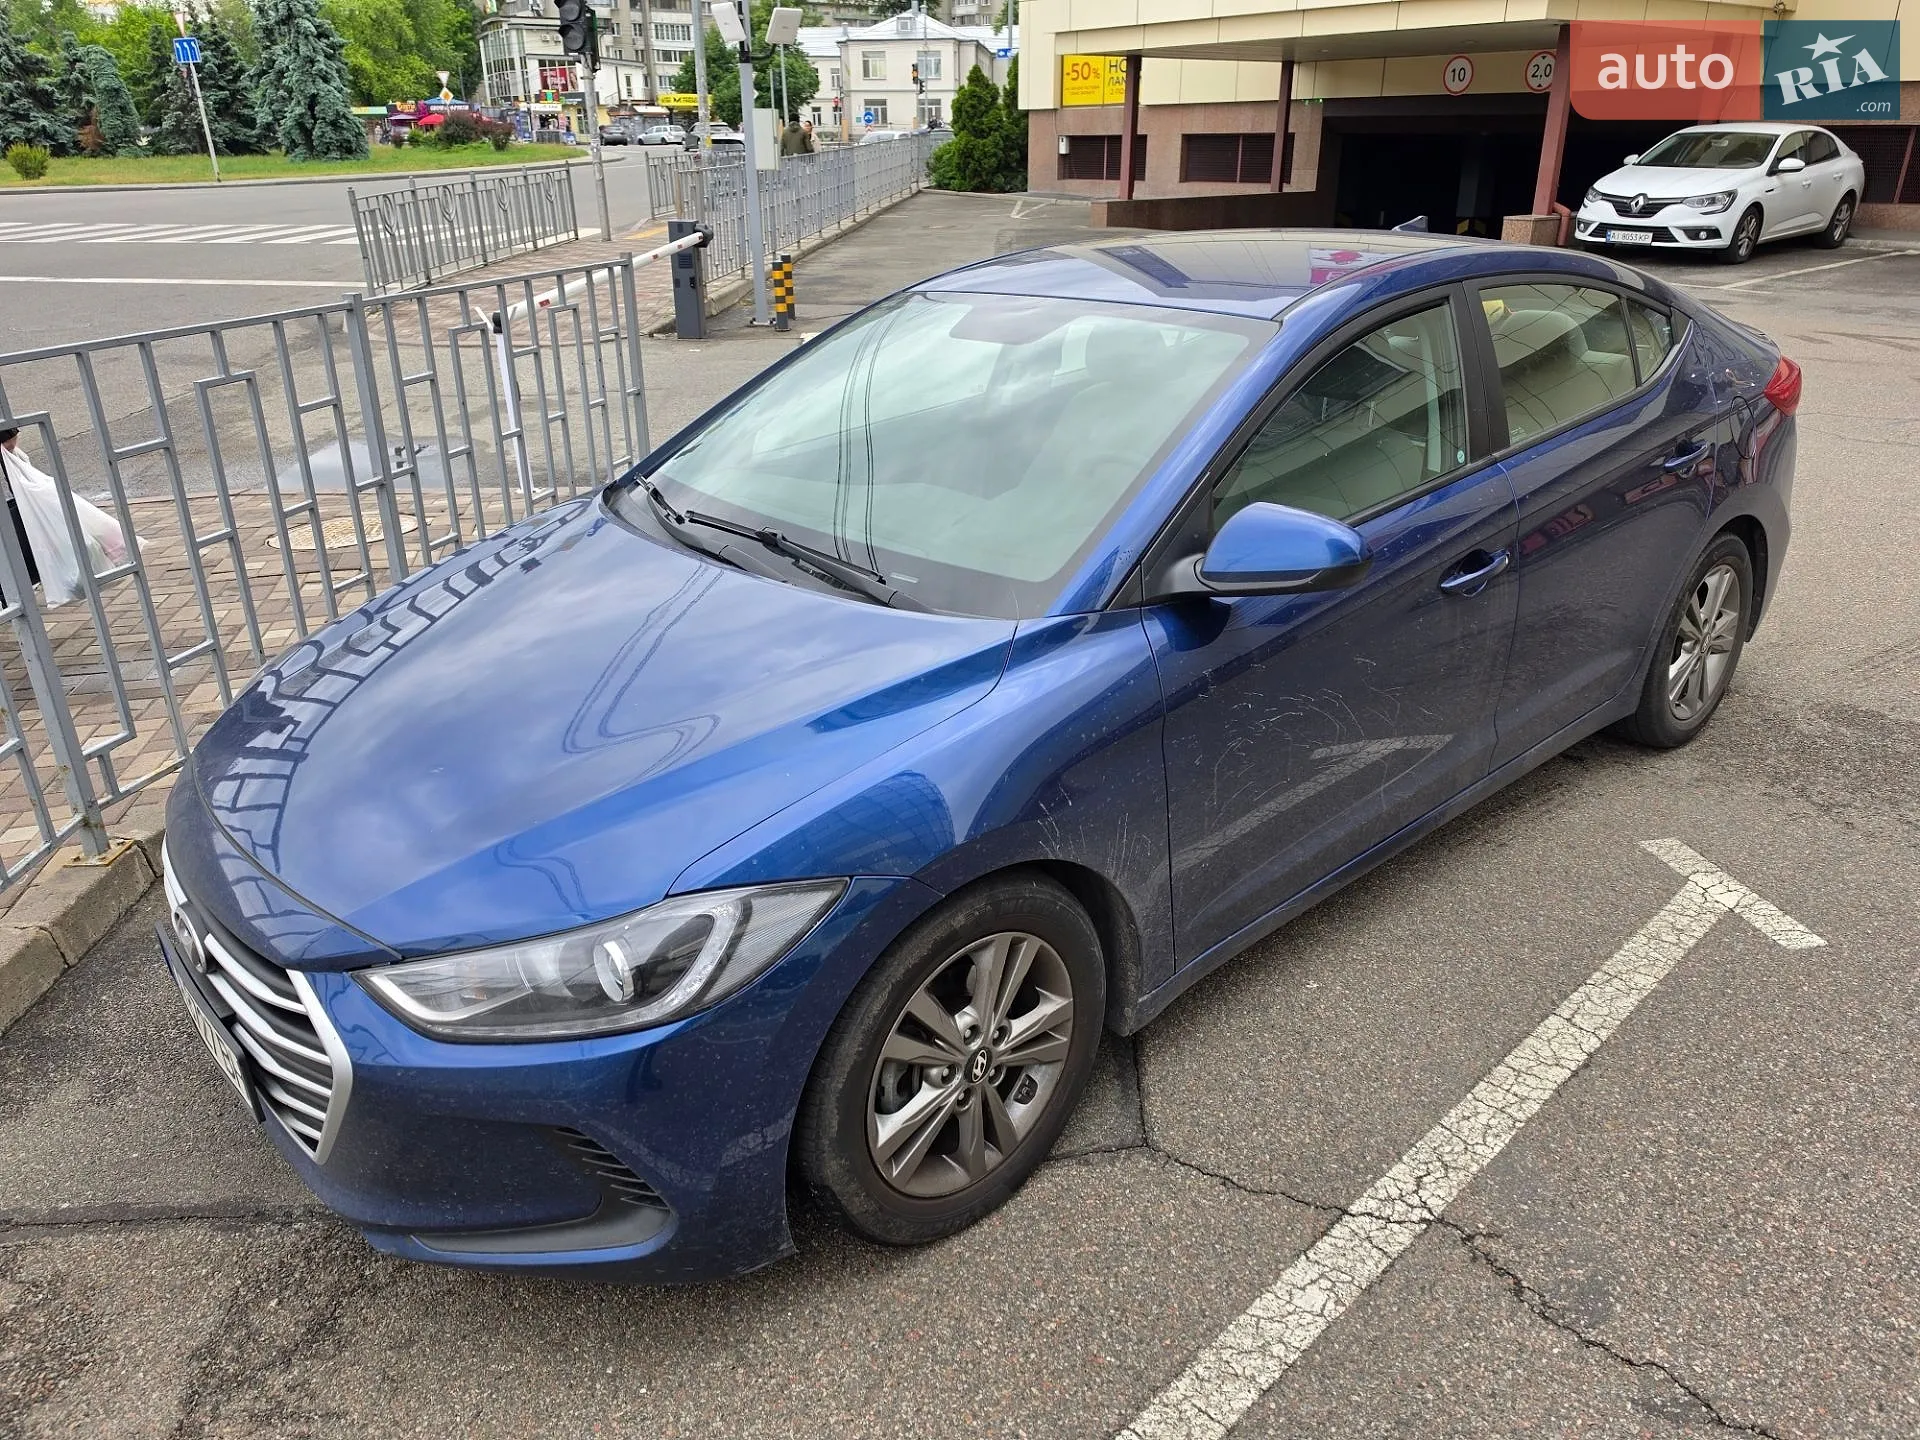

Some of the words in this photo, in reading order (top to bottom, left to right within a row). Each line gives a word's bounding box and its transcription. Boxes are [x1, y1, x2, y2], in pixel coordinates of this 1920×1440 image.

[1066, 62, 1100, 80] -50%
[1451, 67, 1466, 82] 10
[1531, 63, 1552, 80] 2,0
